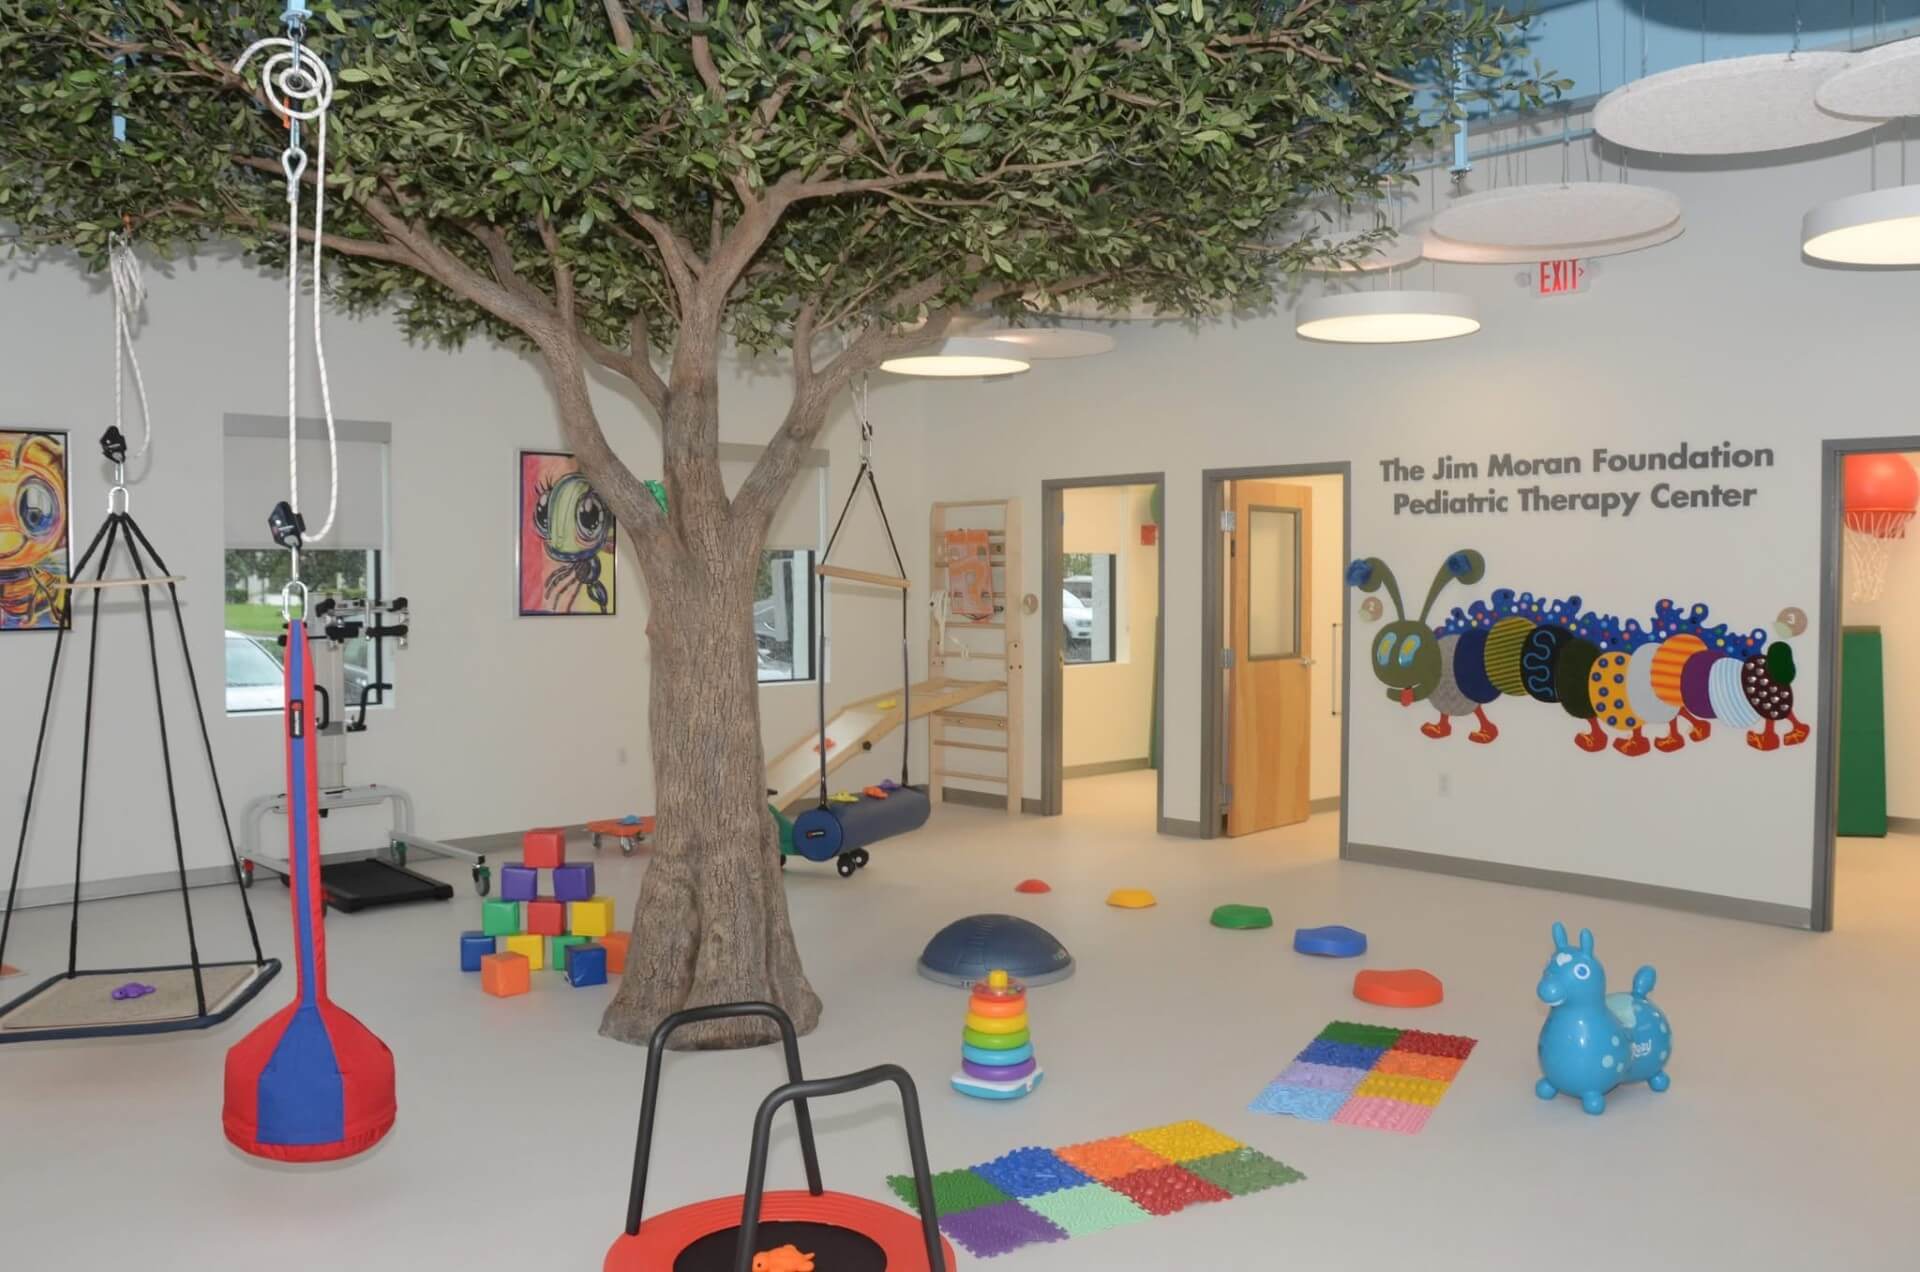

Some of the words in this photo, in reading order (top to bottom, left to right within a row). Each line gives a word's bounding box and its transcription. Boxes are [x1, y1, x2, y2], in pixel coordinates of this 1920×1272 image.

[1540, 260, 1577, 293] EXIT
[1379, 457, 1425, 483] The
[1431, 454, 1479, 481] Jim
[1487, 453, 1582, 478] Moran
[1592, 440, 1775, 473] Foundation
[1393, 487, 1509, 516] Pediatric
[1517, 485, 1641, 518] Therapy
[1650, 482, 1758, 509] Center
[1786, 613, 1796, 625] 3
